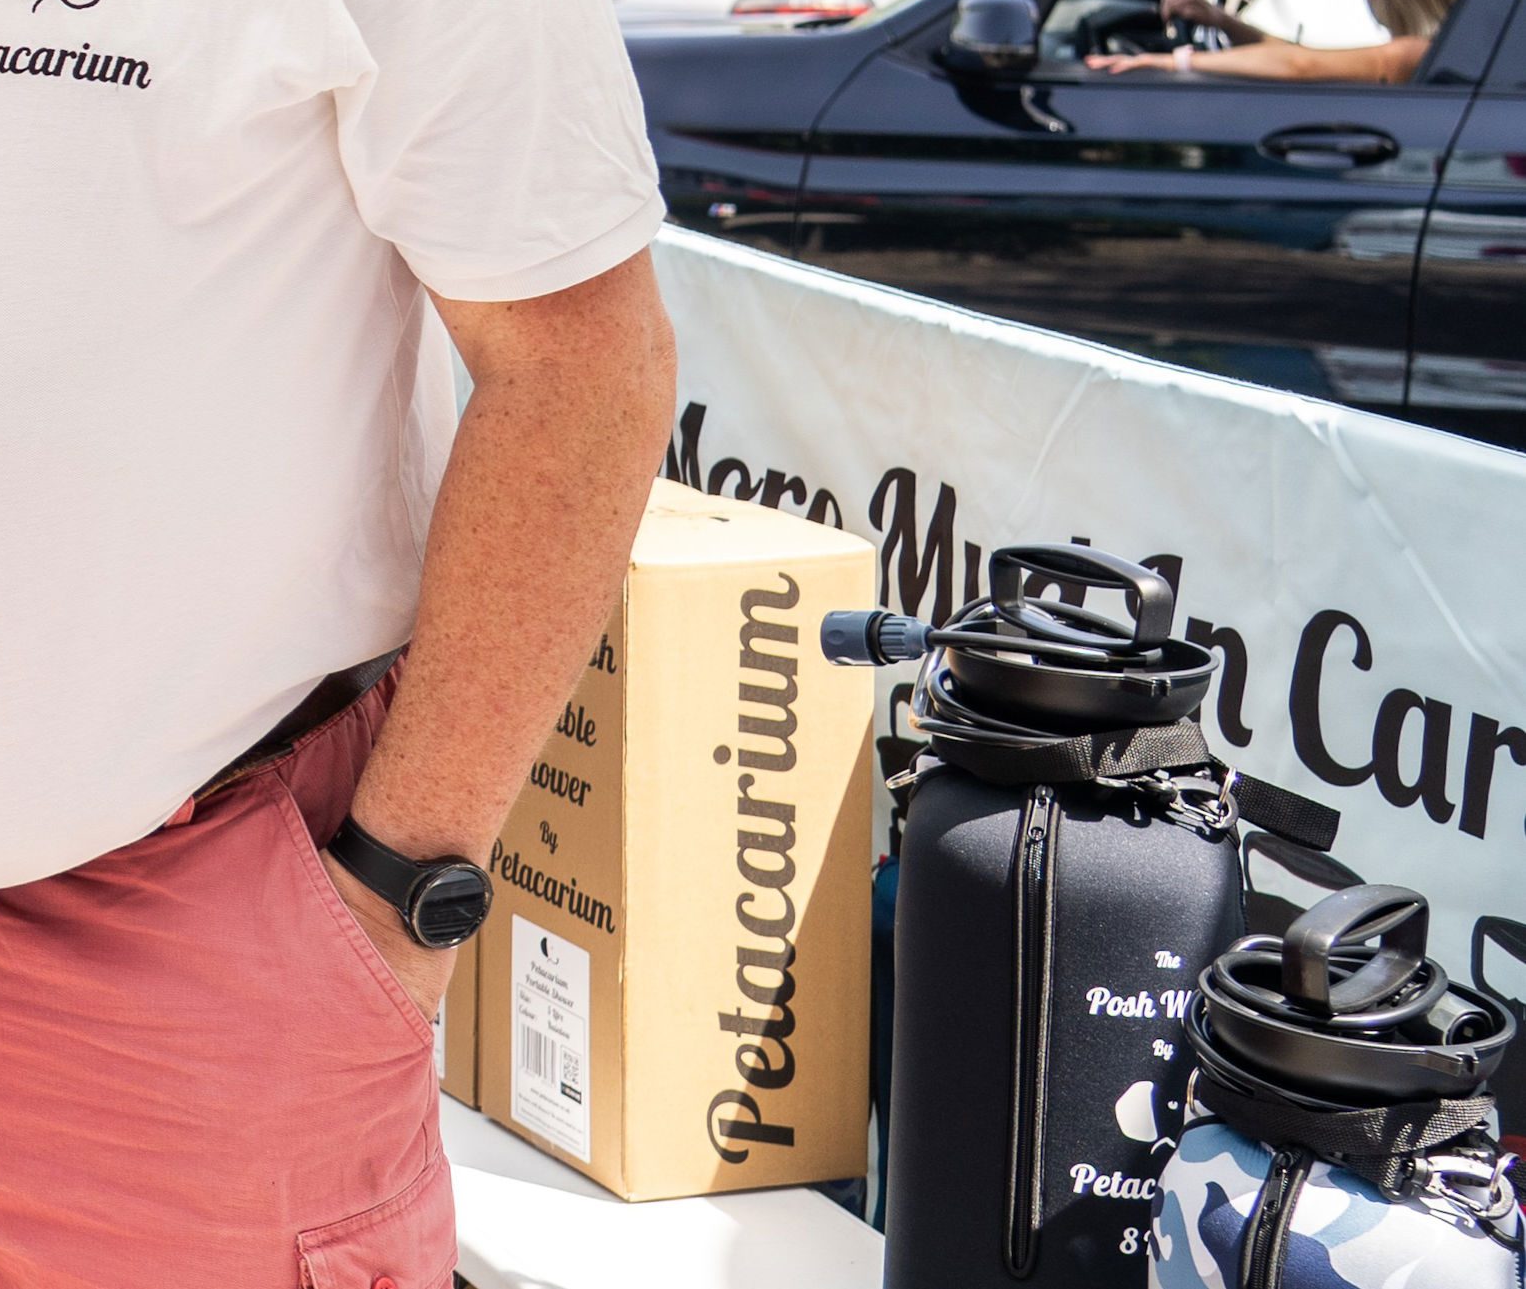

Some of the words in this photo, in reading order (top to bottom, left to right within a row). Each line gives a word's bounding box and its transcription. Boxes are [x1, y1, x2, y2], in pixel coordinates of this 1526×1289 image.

[1289, 609, 1526, 840] Car
[540, 820, 558, 855] By
[705, 570, 800, 1165] Petacarium
[489, 837, 616, 935] Petacarium
[1155, 950, 1181, 969] The
[1085, 986, 1156, 1018] Posh
[1153, 1038, 1174, 1060] By
